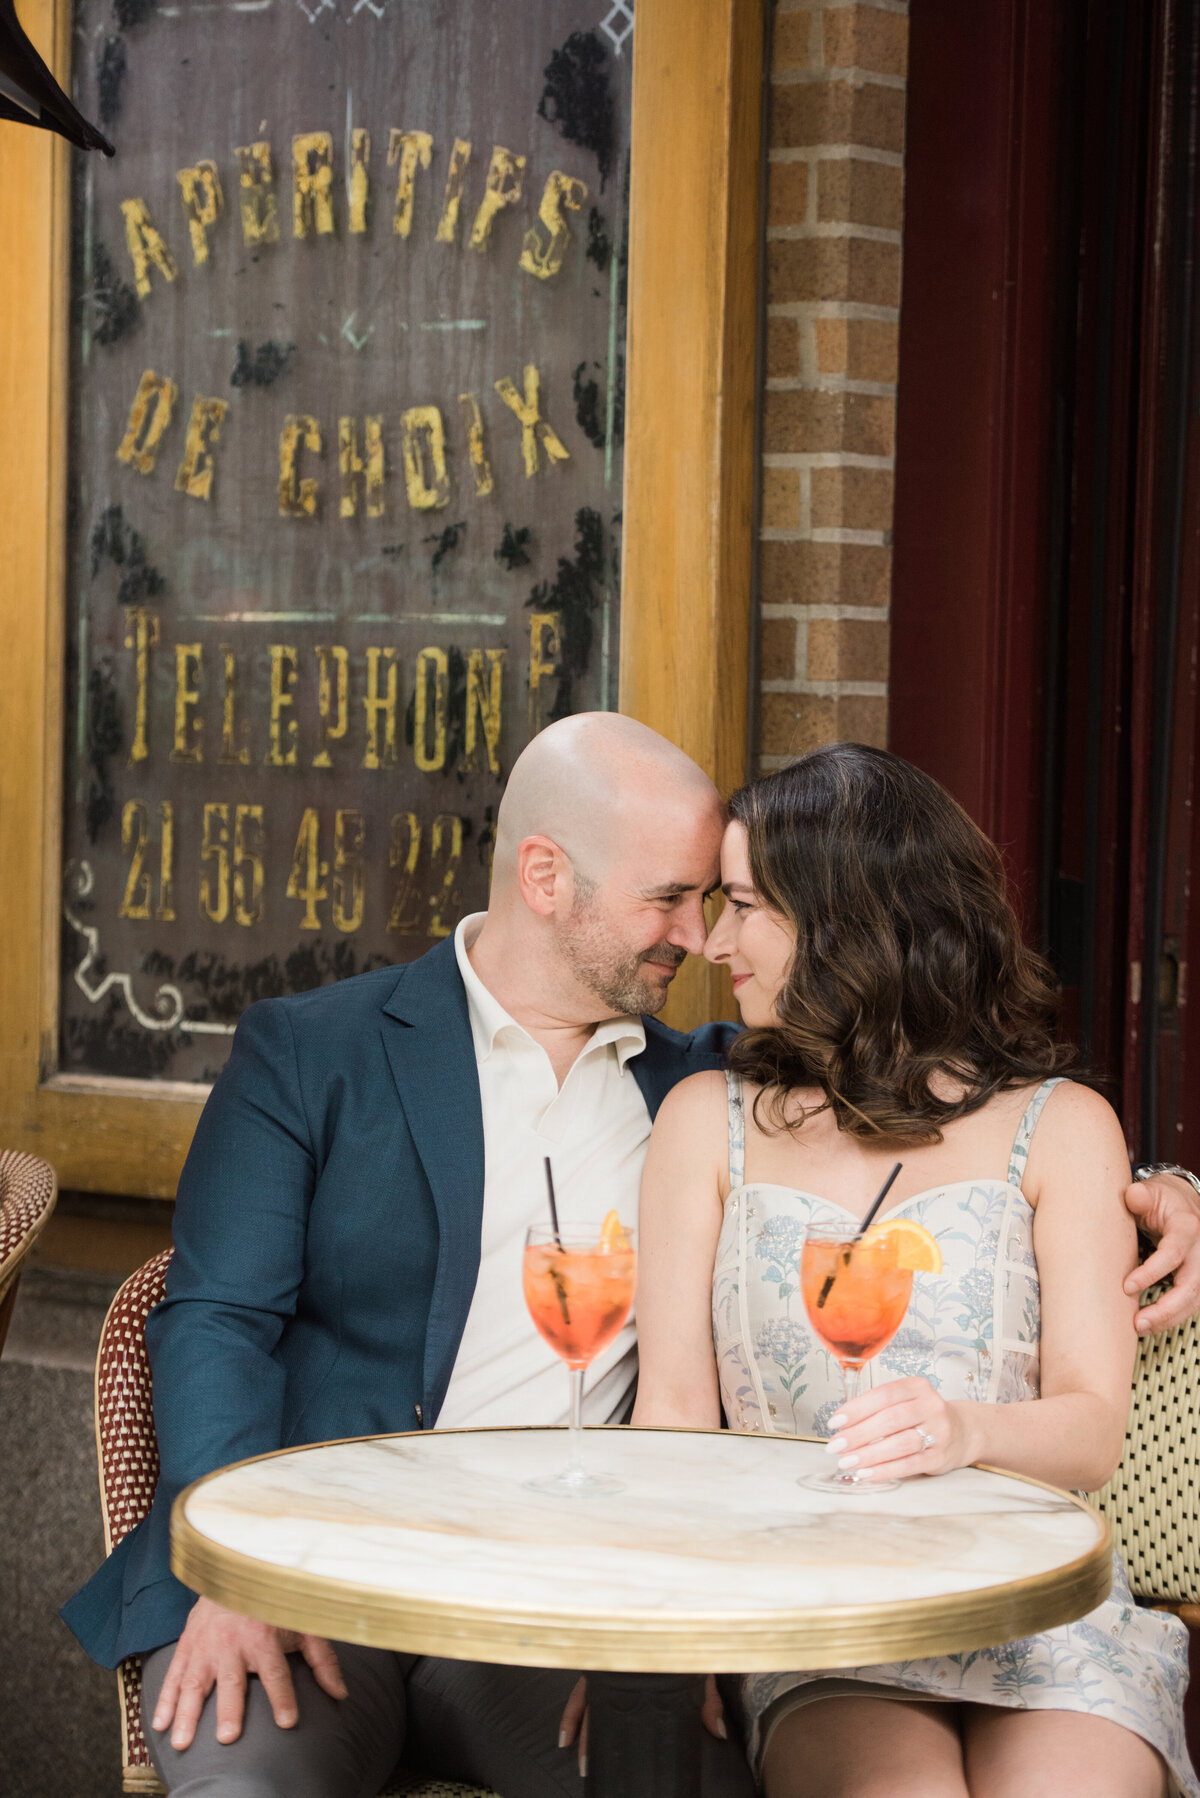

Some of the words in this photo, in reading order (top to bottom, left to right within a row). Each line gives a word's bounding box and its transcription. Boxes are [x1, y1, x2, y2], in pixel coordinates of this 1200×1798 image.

[117, 369, 228, 500] DE
[279, 364, 571, 517] CHOIX
[118, 798, 176, 921] 21
[286, 807, 366, 933] 45
[386, 811, 463, 937] 22
